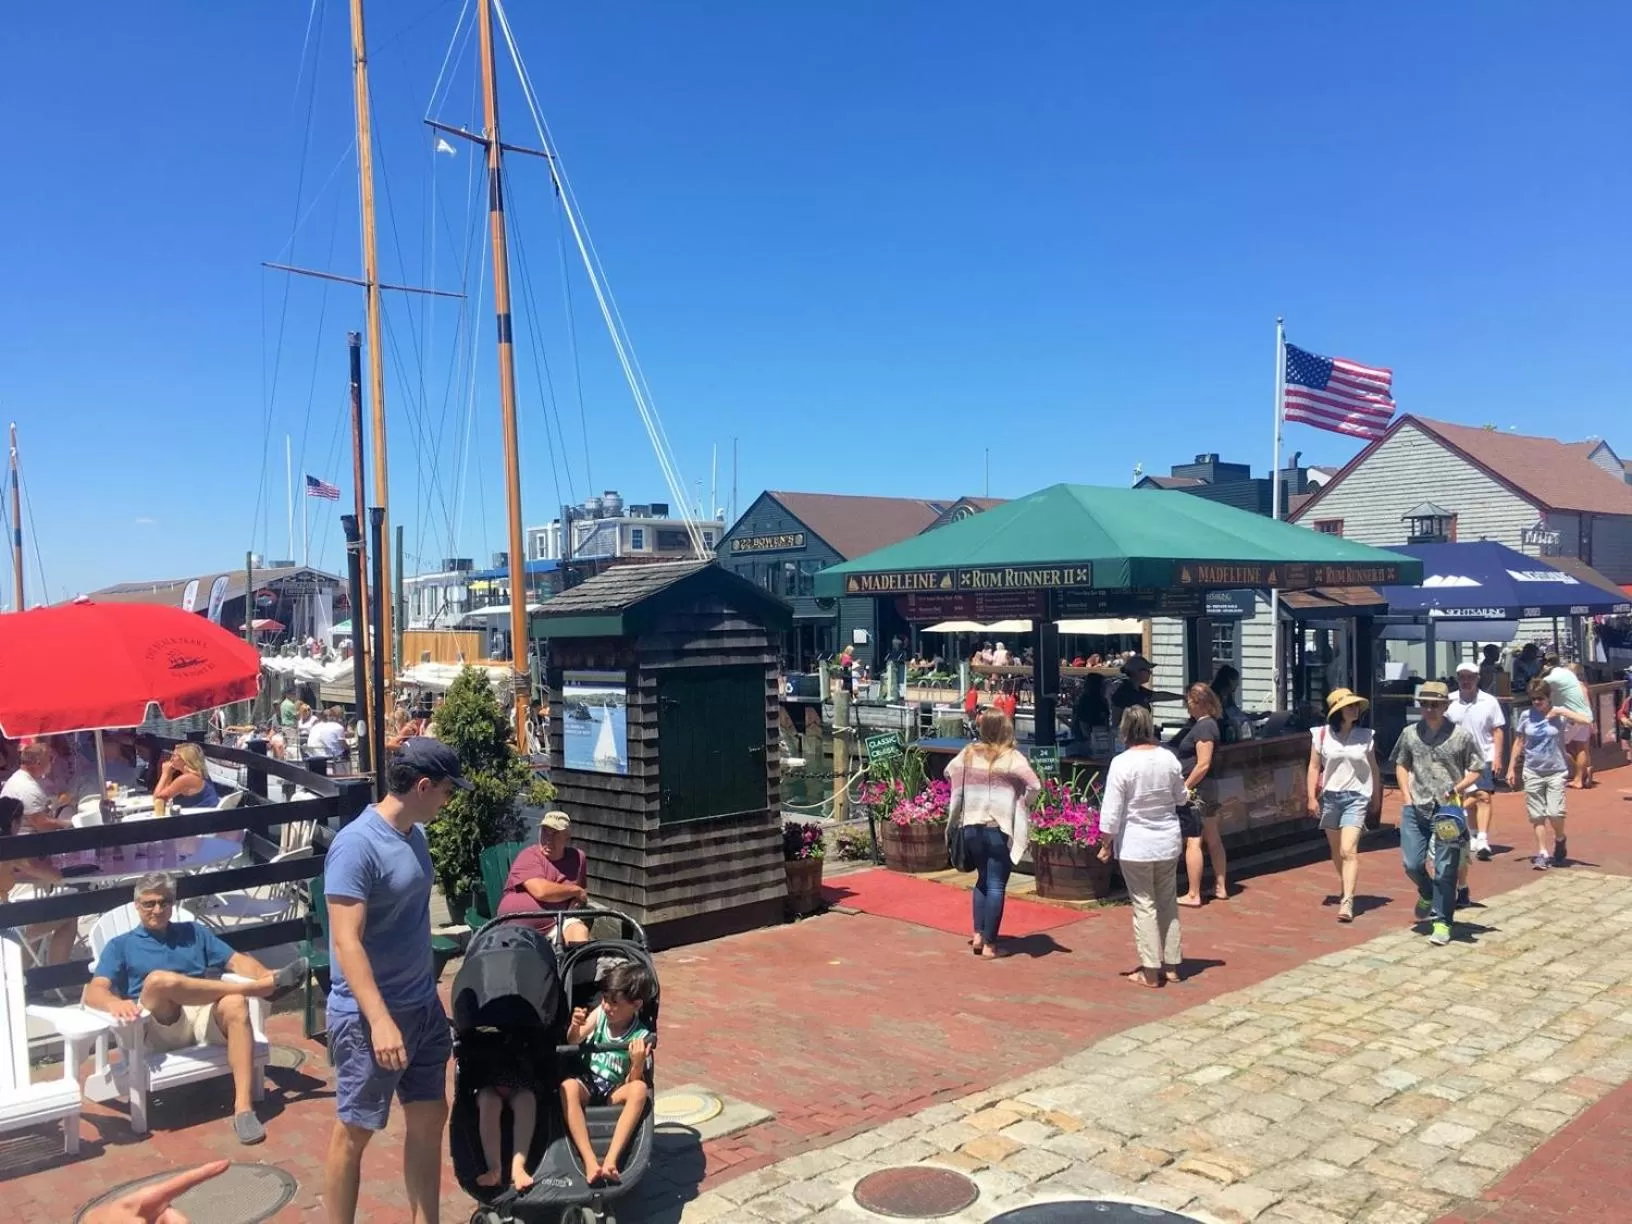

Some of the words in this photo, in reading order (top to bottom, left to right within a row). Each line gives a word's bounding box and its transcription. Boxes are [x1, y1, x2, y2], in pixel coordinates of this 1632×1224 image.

[754, 535, 794, 548] BOWEN'S
[861, 573, 937, 590] MADELEINE
[972, 570, 1002, 588] RUM
[1004, 568, 1060, 586] RUNNER
[1063, 569, 1074, 584] II
[1198, 566, 1261, 584] MADELEINE
[869, 735, 896, 748] CLASSIC
